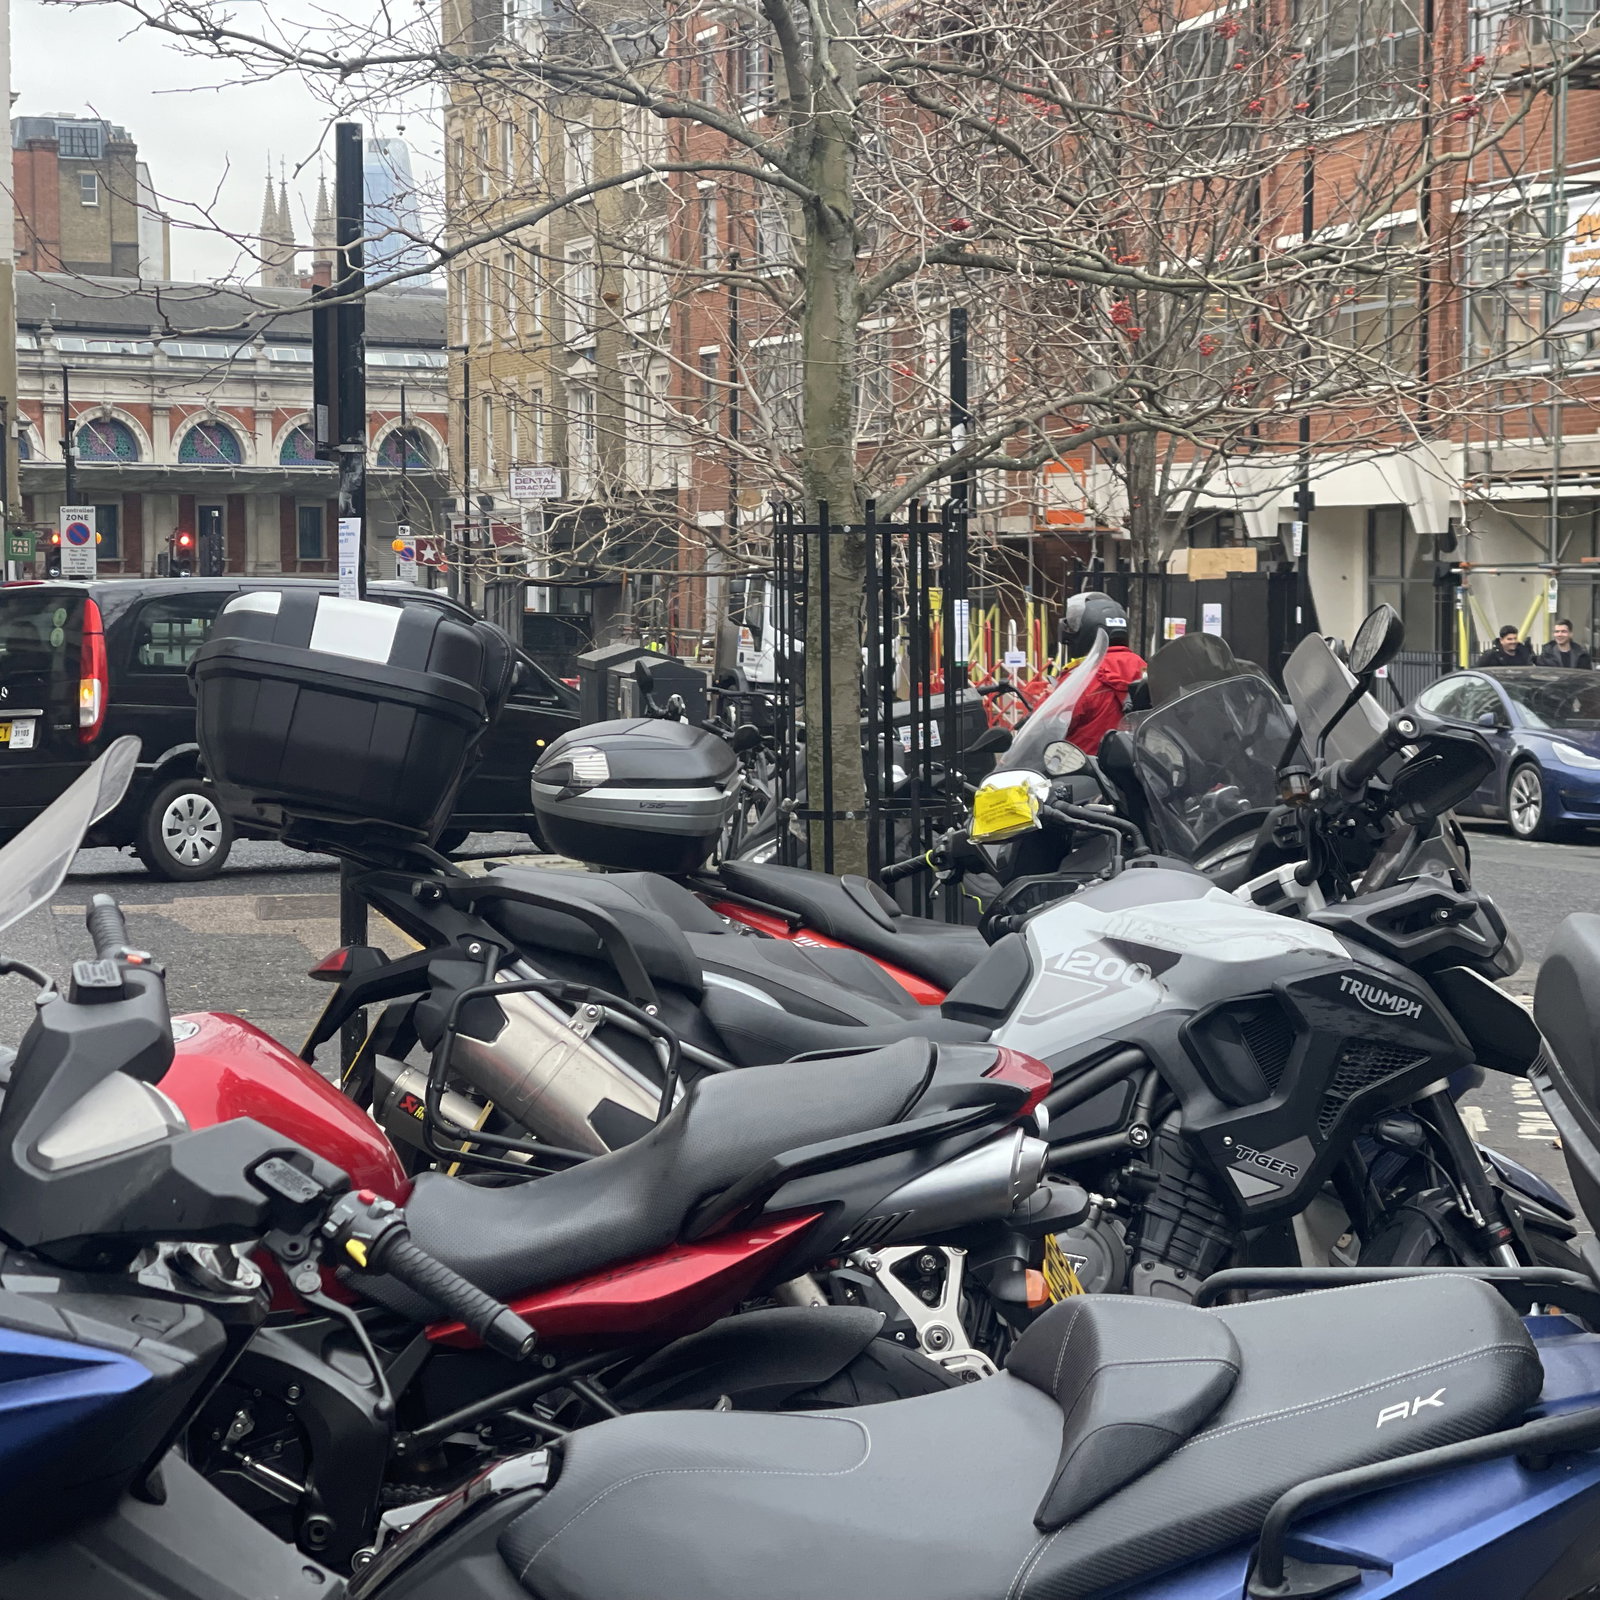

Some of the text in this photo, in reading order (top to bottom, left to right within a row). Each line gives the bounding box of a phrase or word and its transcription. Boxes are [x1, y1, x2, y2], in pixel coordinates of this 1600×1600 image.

[0, 725, 11, 739] Y
[1054, 949, 1152, 987] 1200
[1340, 975, 1423, 1019] TRIUMPH
[1235, 1144, 1300, 1179] TIGER
[1376, 1387, 1447, 1429] AK
